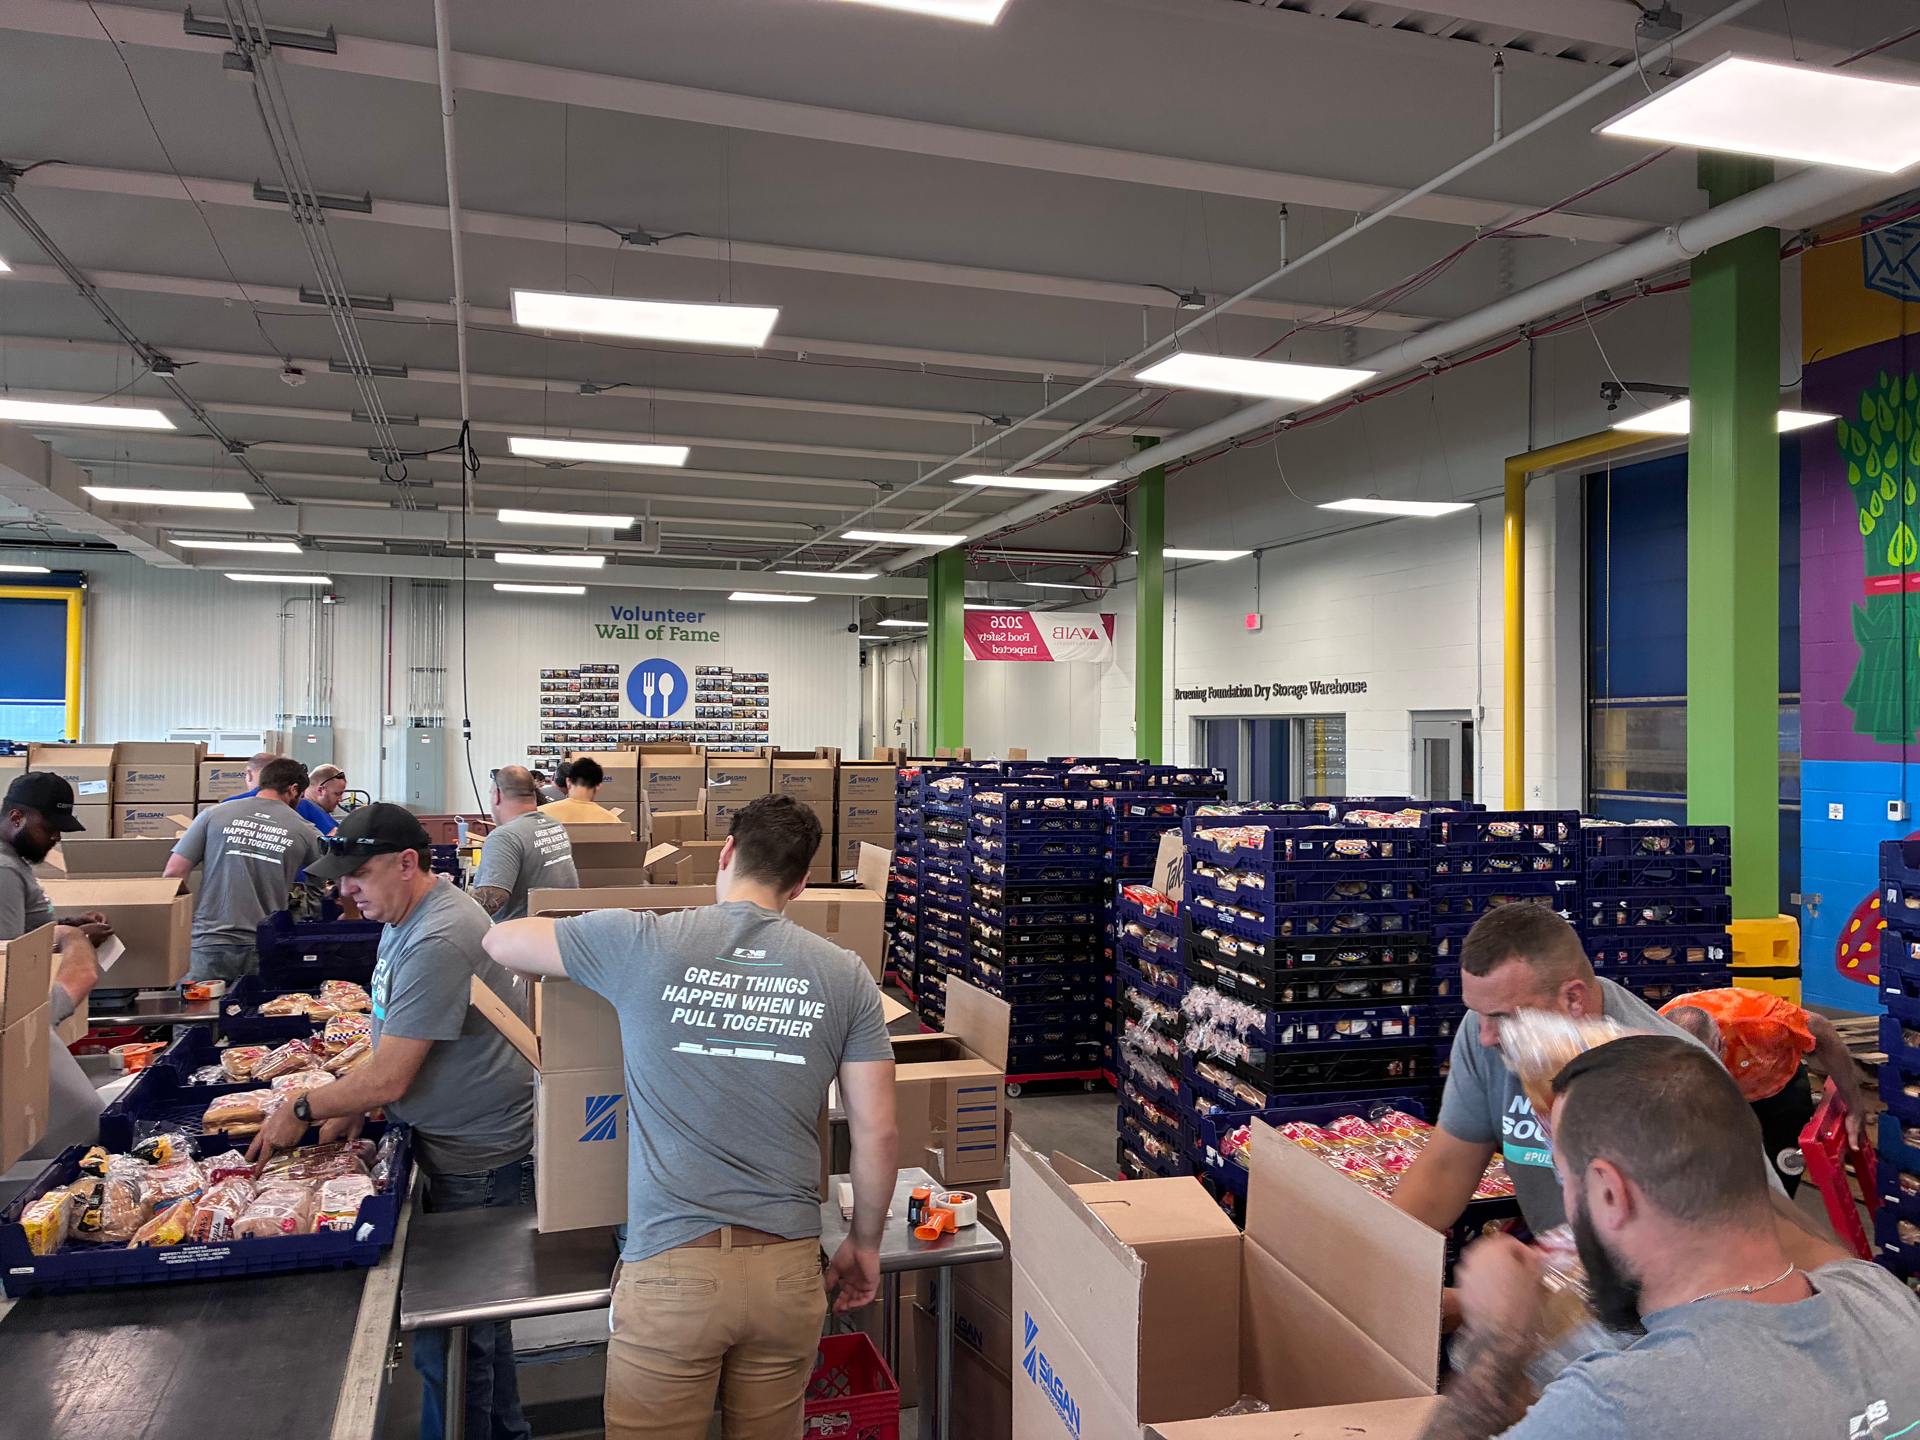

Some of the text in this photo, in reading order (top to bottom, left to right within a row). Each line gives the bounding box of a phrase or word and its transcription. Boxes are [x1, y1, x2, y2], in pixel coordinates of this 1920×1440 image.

[610, 605, 706, 623] Volunteer
[594, 623, 720, 642] Wall of Fame
[1174, 678, 1368, 703] Bruening Foundation Dry Storage Warehouse
[222, 826, 294, 848] HAPPEN WHEN WE
[232, 819, 288, 836] GREAT THINGS
[226, 835, 287, 854] PULL TOGETHER
[684, 966, 811, 995] GREAT THINGS
[661, 984, 826, 1020] HAPPEN WHEN WE
[670, 1007, 814, 1039] PULL TOGETHER
[954, 1311, 983, 1348] LGAN
[1039, 1351, 1081, 1435] SILGAN
